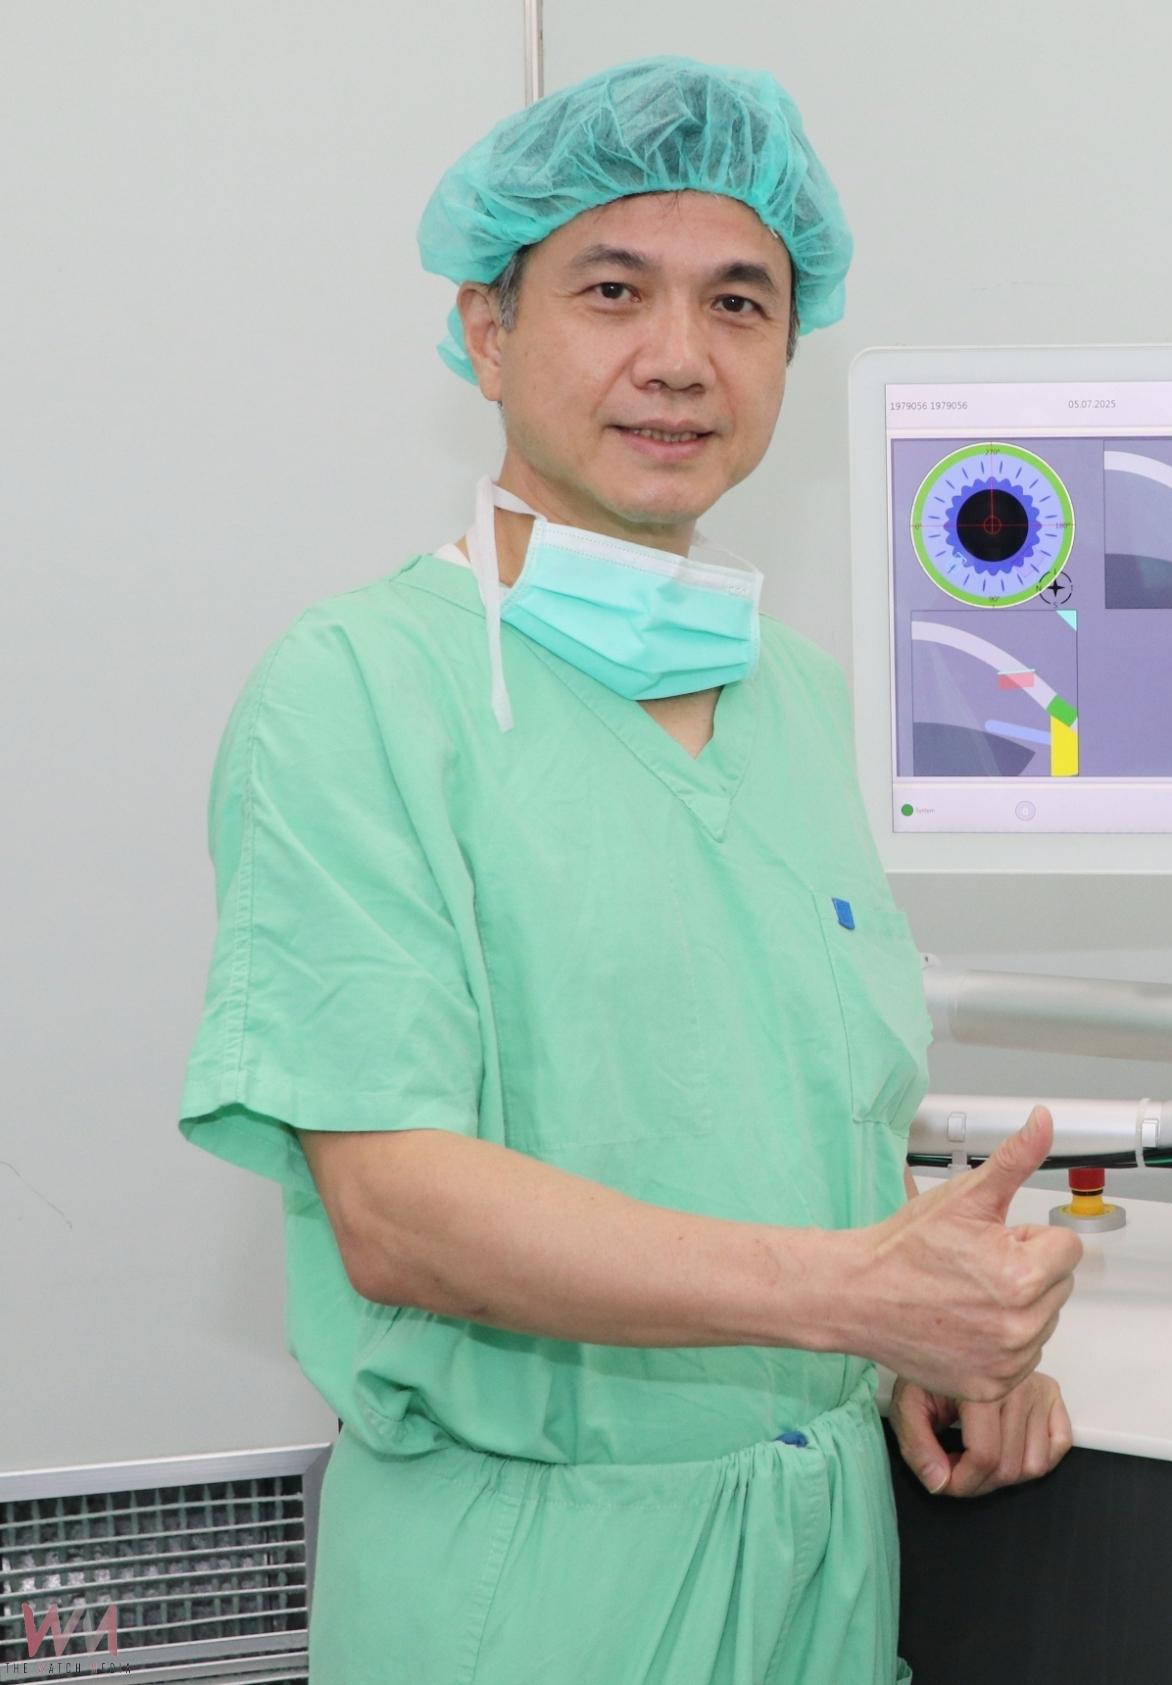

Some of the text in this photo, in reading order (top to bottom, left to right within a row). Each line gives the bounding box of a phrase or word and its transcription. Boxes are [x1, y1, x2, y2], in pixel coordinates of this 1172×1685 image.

[890, 400, 968, 411] 1979056 1979056
[1068, 399, 1117, 409] 05.07.2025
